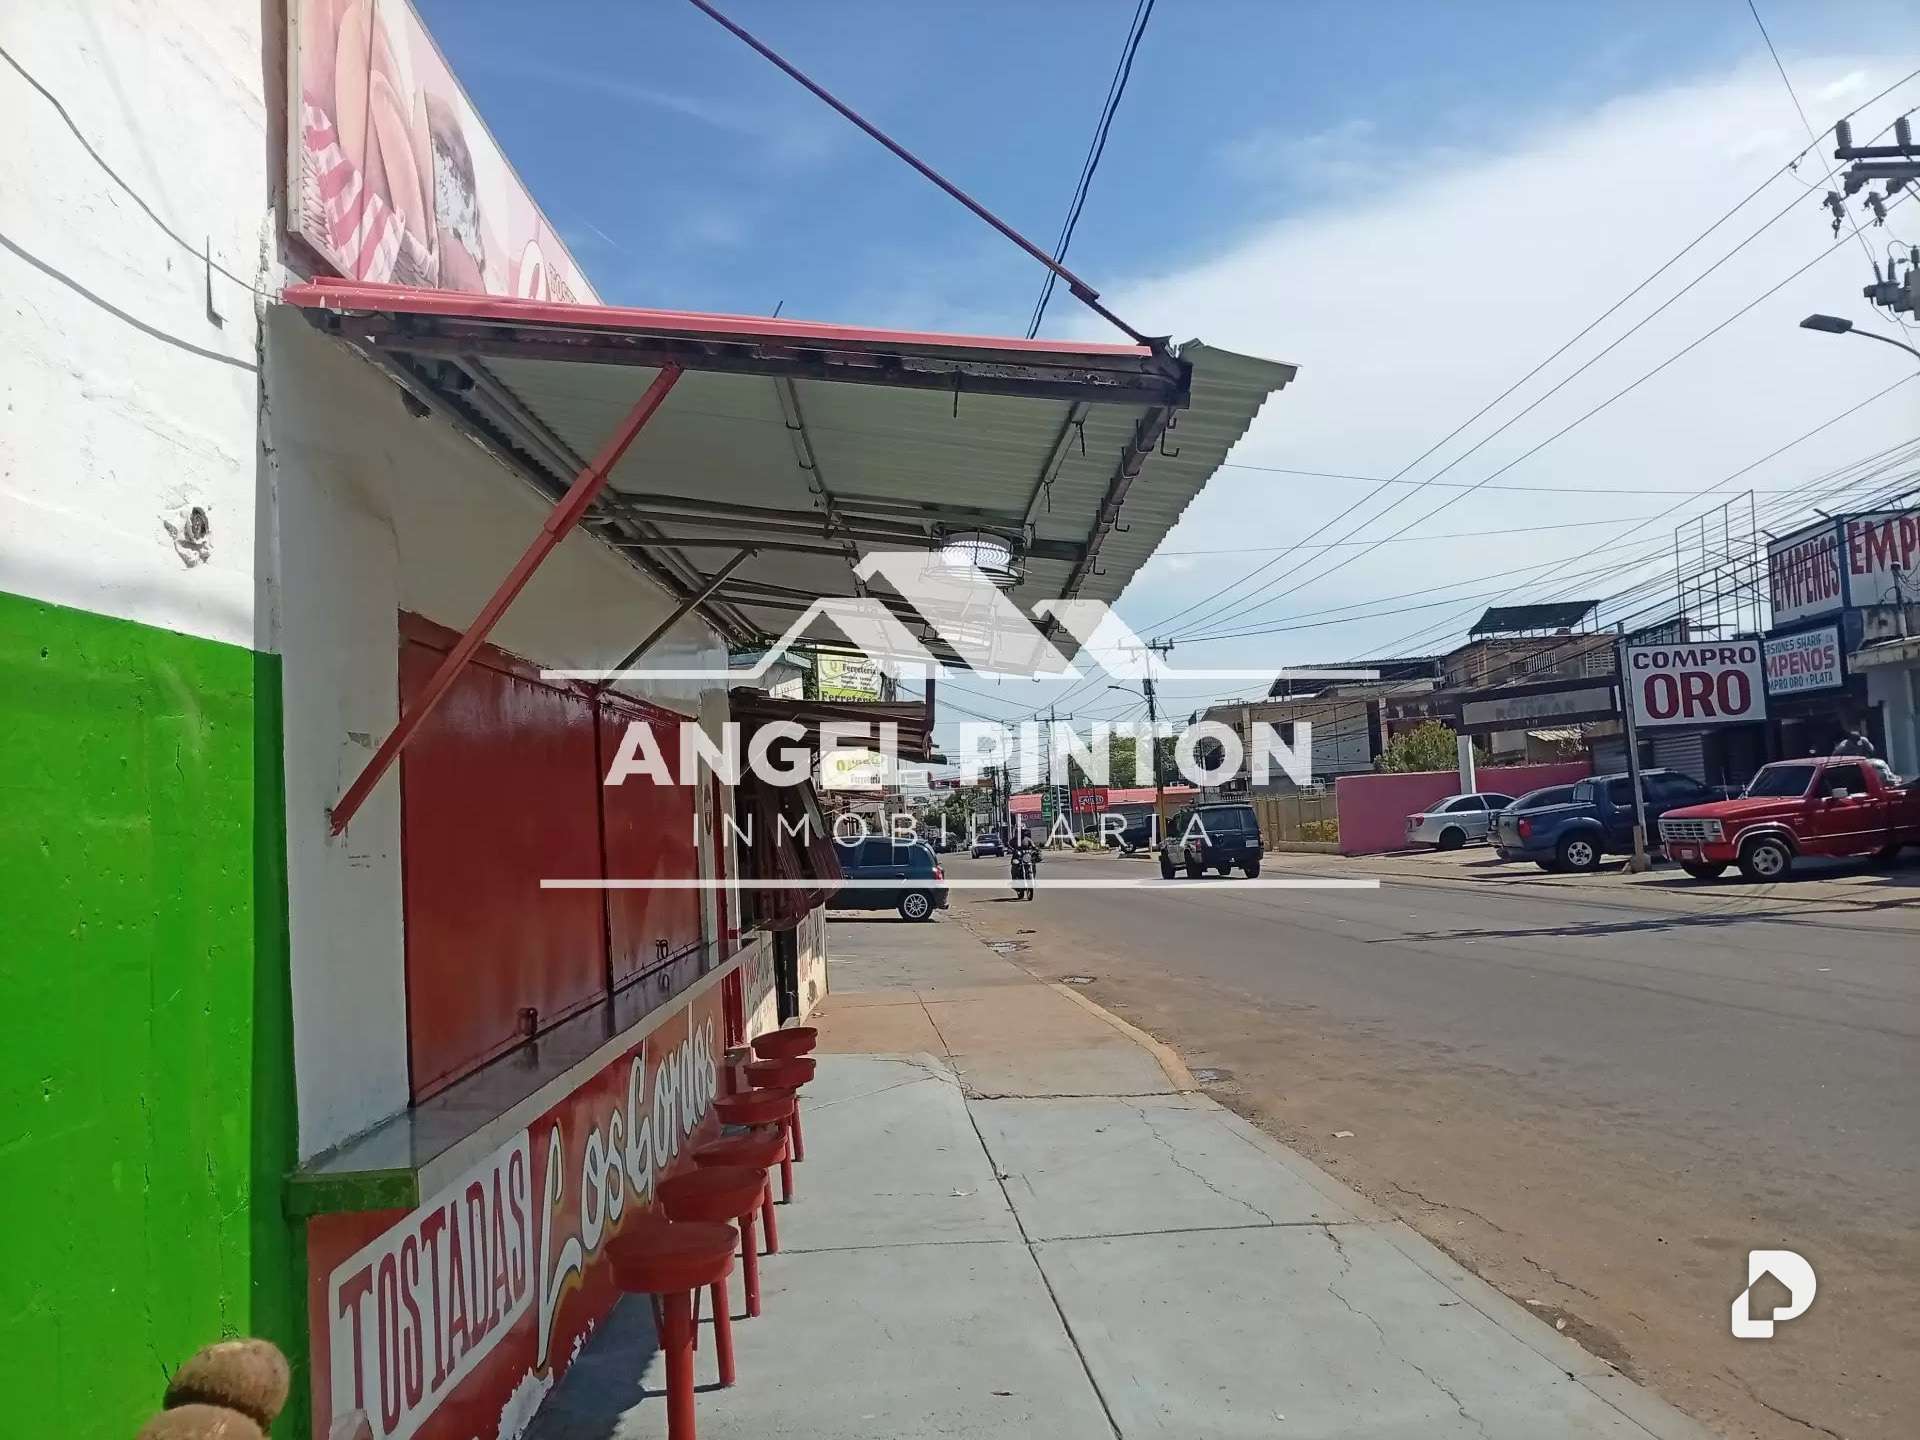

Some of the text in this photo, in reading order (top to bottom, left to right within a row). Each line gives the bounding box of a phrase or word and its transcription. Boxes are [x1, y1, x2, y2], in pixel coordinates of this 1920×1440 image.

[1847, 516, 1920, 575] EMP
[1633, 646, 1756, 670] COMPRO
[1809, 671, 1833, 686] PLATA
[1644, 669, 1751, 719] ORO
[339, 998, 719, 1435] TOSTADAS Los Gordos
